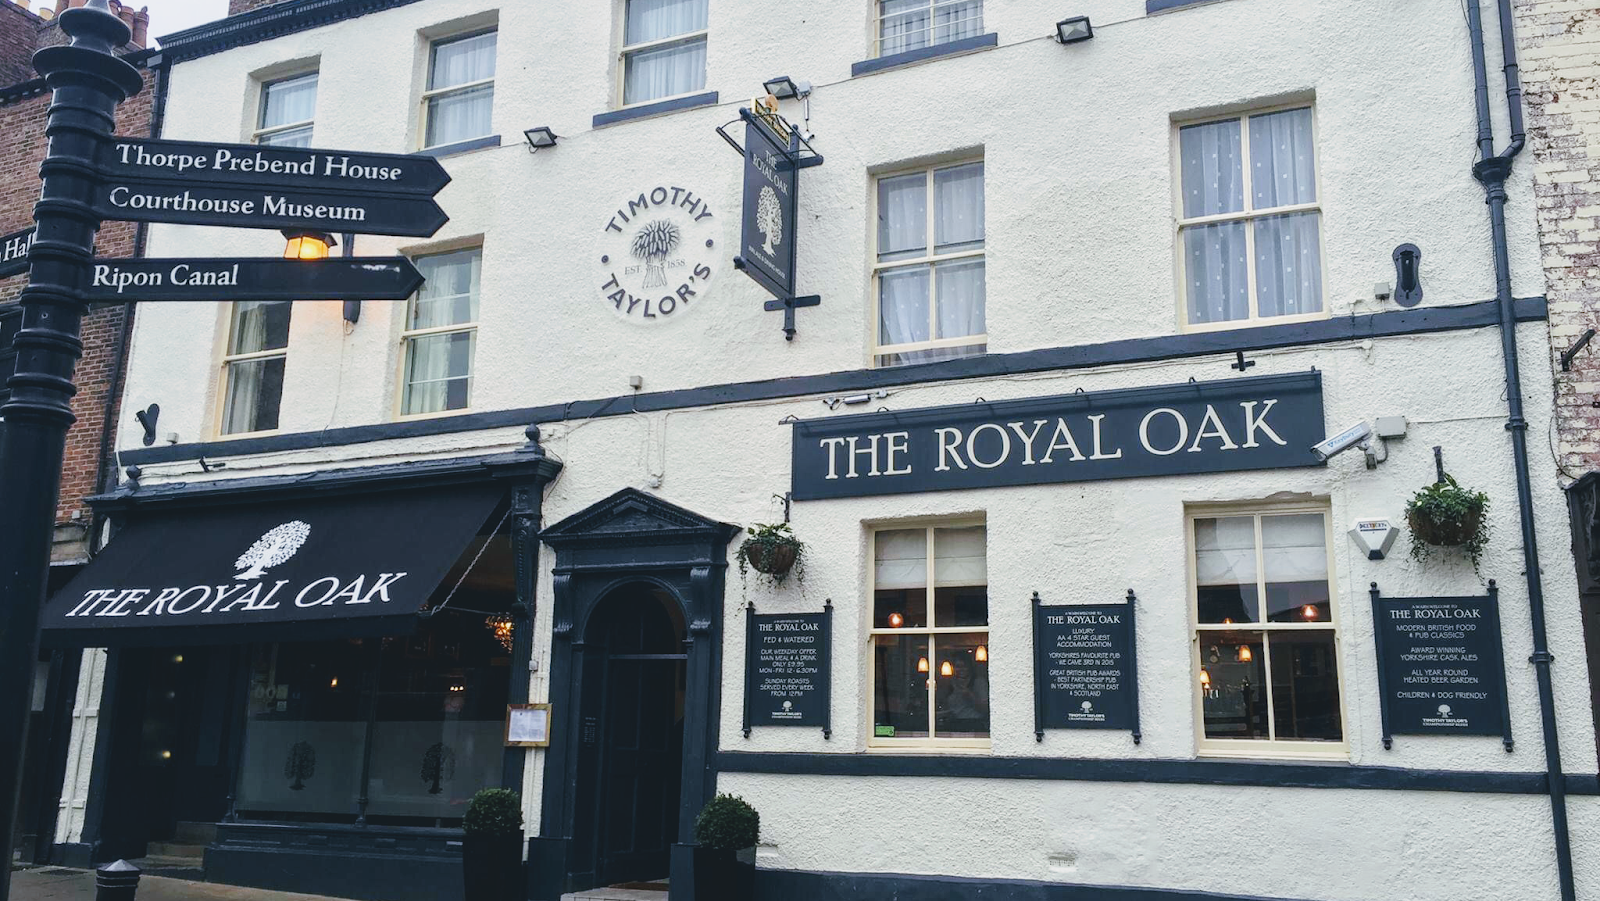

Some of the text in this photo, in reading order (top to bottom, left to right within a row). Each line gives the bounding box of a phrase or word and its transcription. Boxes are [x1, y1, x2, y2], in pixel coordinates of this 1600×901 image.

[116, 143, 402, 182] Thorpe Prebend House
[752, 154, 788, 196] ROYAL OAK
[765, 150, 777, 170] THE
[108, 187, 366, 221] Courthouse Museum
[605, 186, 713, 233] TIMOTHY
[92, 264, 238, 294] Ripon Canal
[624, 259, 686, 275] EST. 1858
[601, 263, 711, 318] TAYLOR'S
[820, 399, 1288, 480] THE ROYAL OAK
[65, 572, 408, 617] THE ROYAL OAK
[1047, 616, 1120, 624] THE ROYAL OAK
[1390, 609, 1481, 618] THE ROYAL OAK
